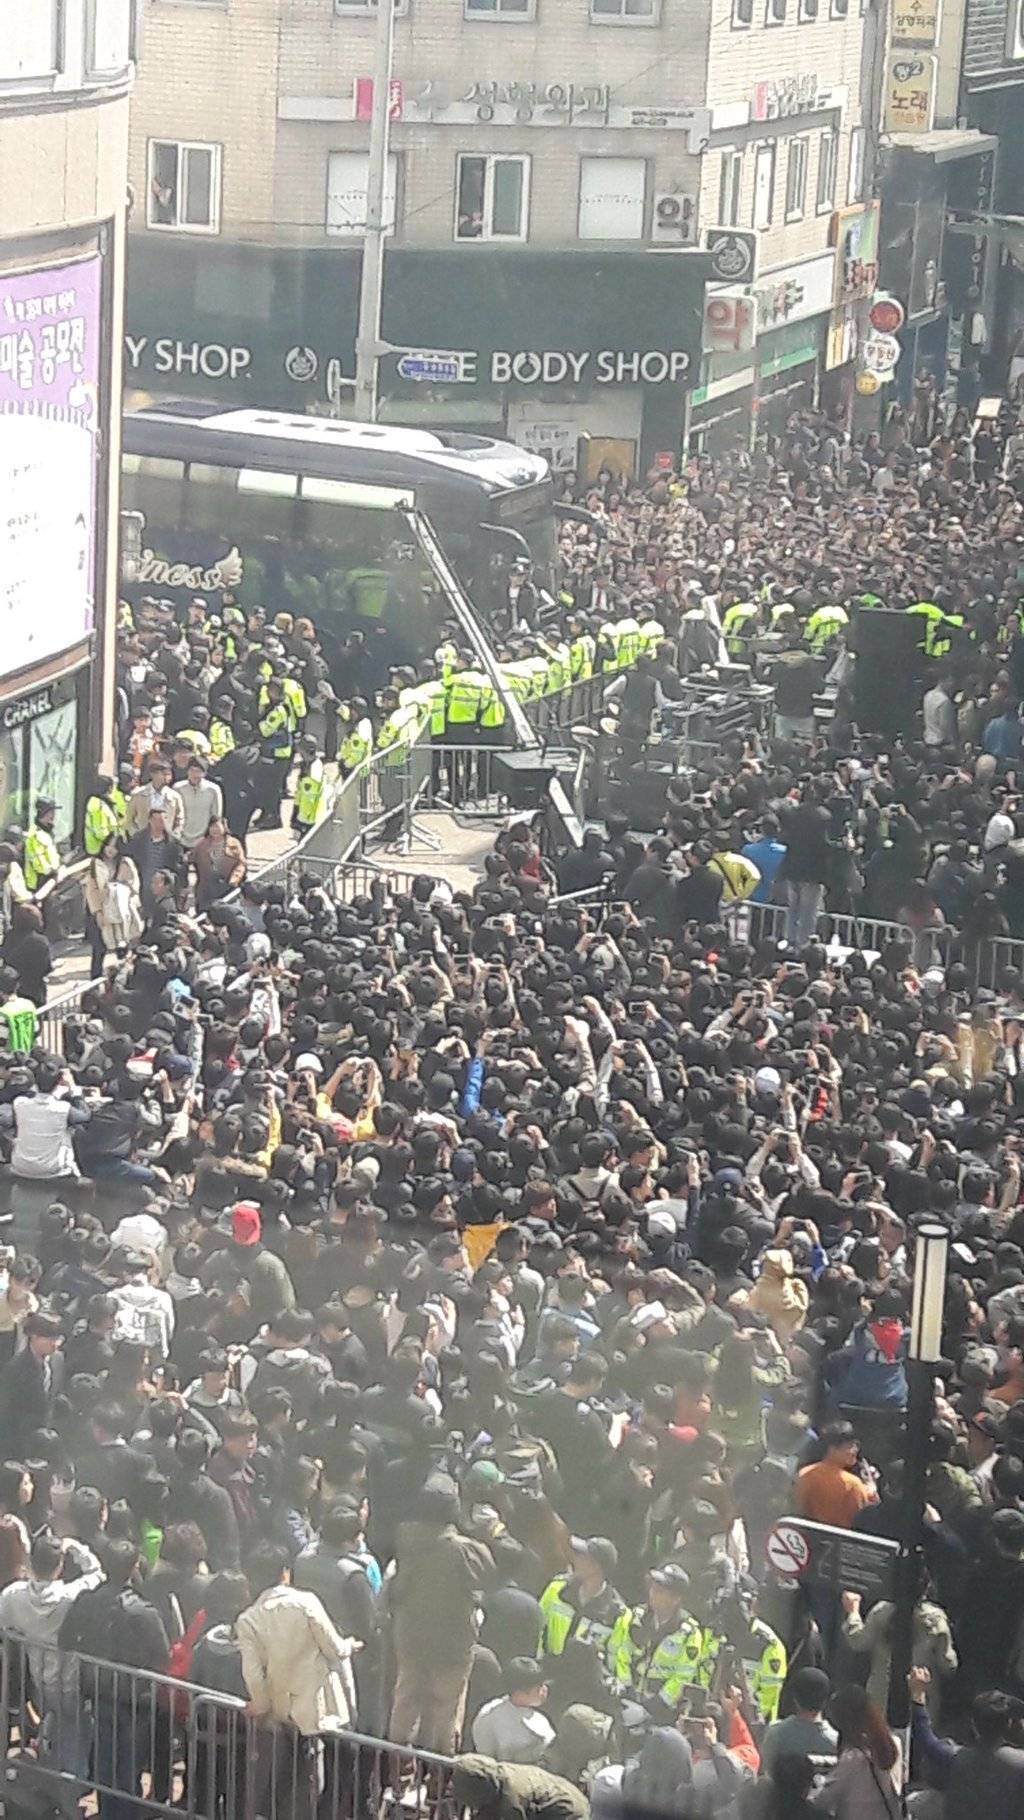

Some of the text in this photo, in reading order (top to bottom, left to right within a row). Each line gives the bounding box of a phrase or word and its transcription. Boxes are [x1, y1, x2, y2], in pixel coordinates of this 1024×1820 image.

[892, 90, 928, 111] 노래
[0, 317, 84, 389] 미술 공모전
[155, 339, 251, 378] SHOP
[491, 352, 589, 383] BODY
[597, 352, 689, 383] SHOP
